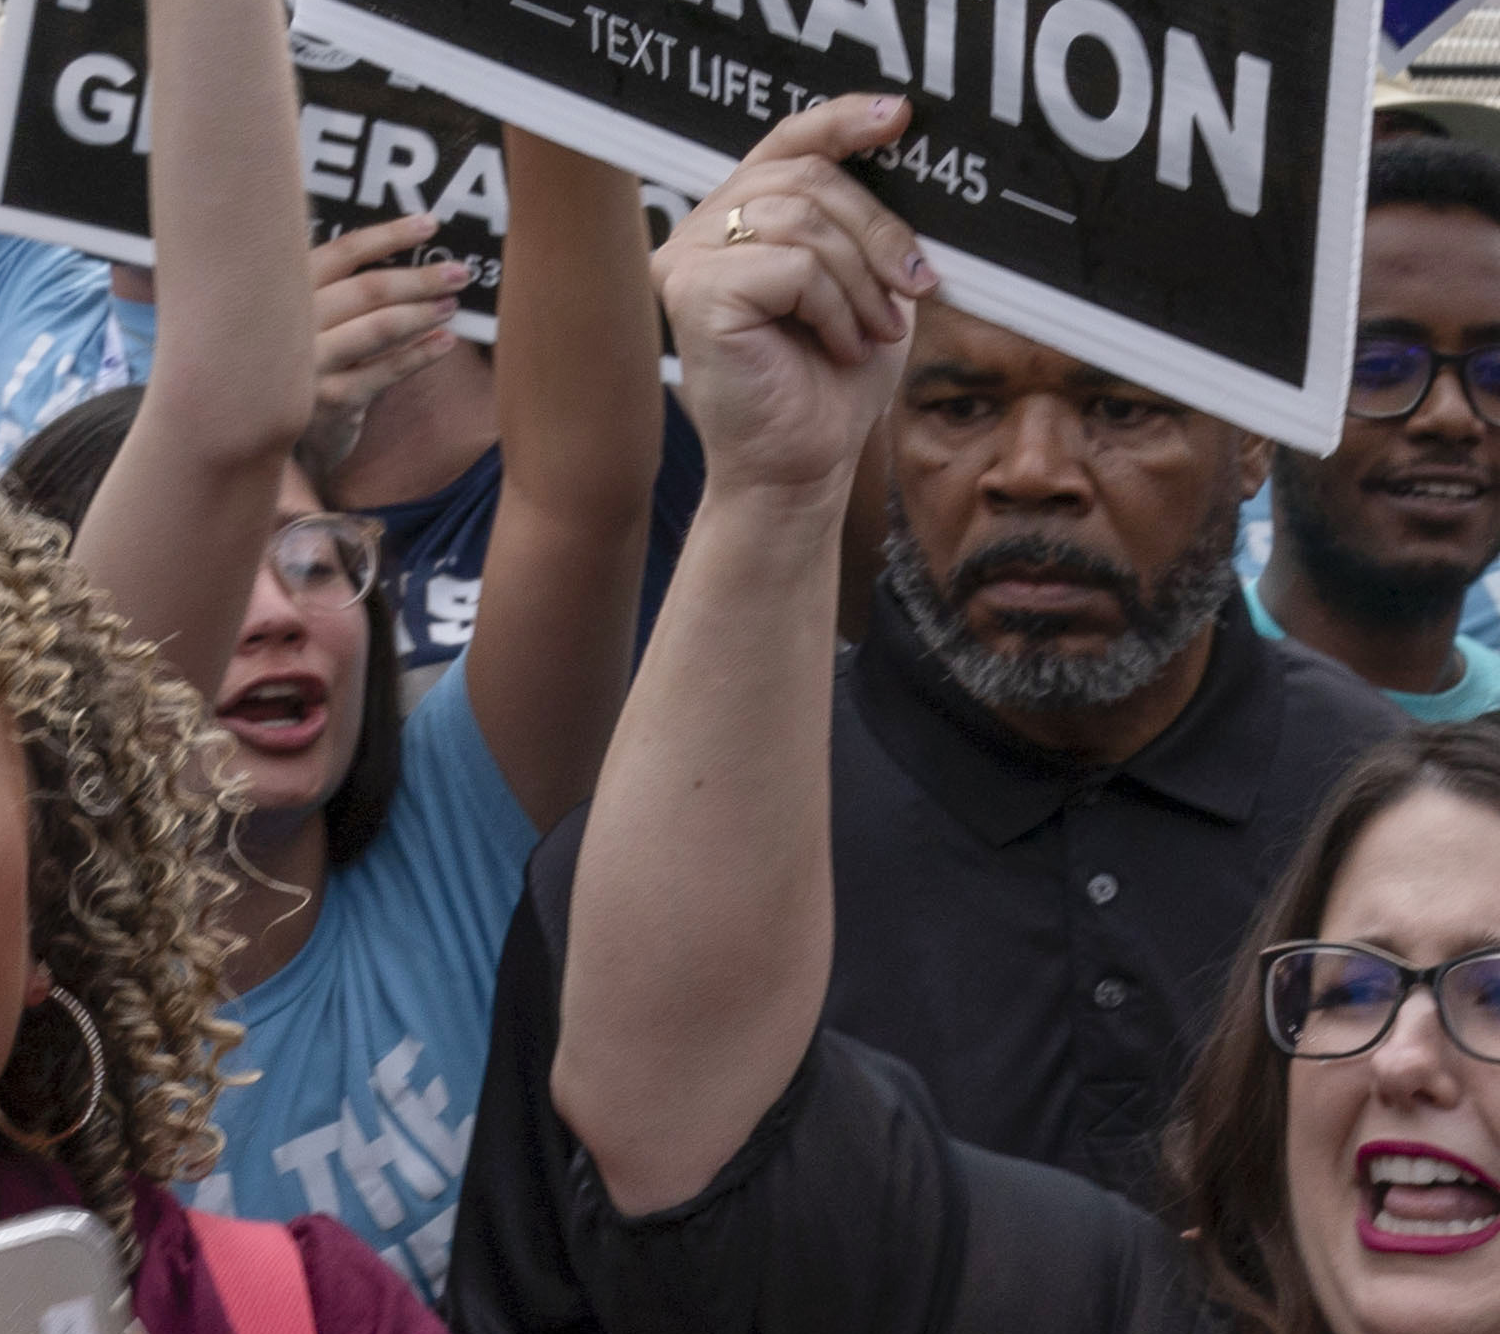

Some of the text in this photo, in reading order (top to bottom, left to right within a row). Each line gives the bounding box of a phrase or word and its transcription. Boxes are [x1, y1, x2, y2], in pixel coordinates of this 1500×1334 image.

[582, 3, 678, 83] TEXT
[689, 51, 773, 123] LIFE
[271, 1032, 476, 1231] THE
